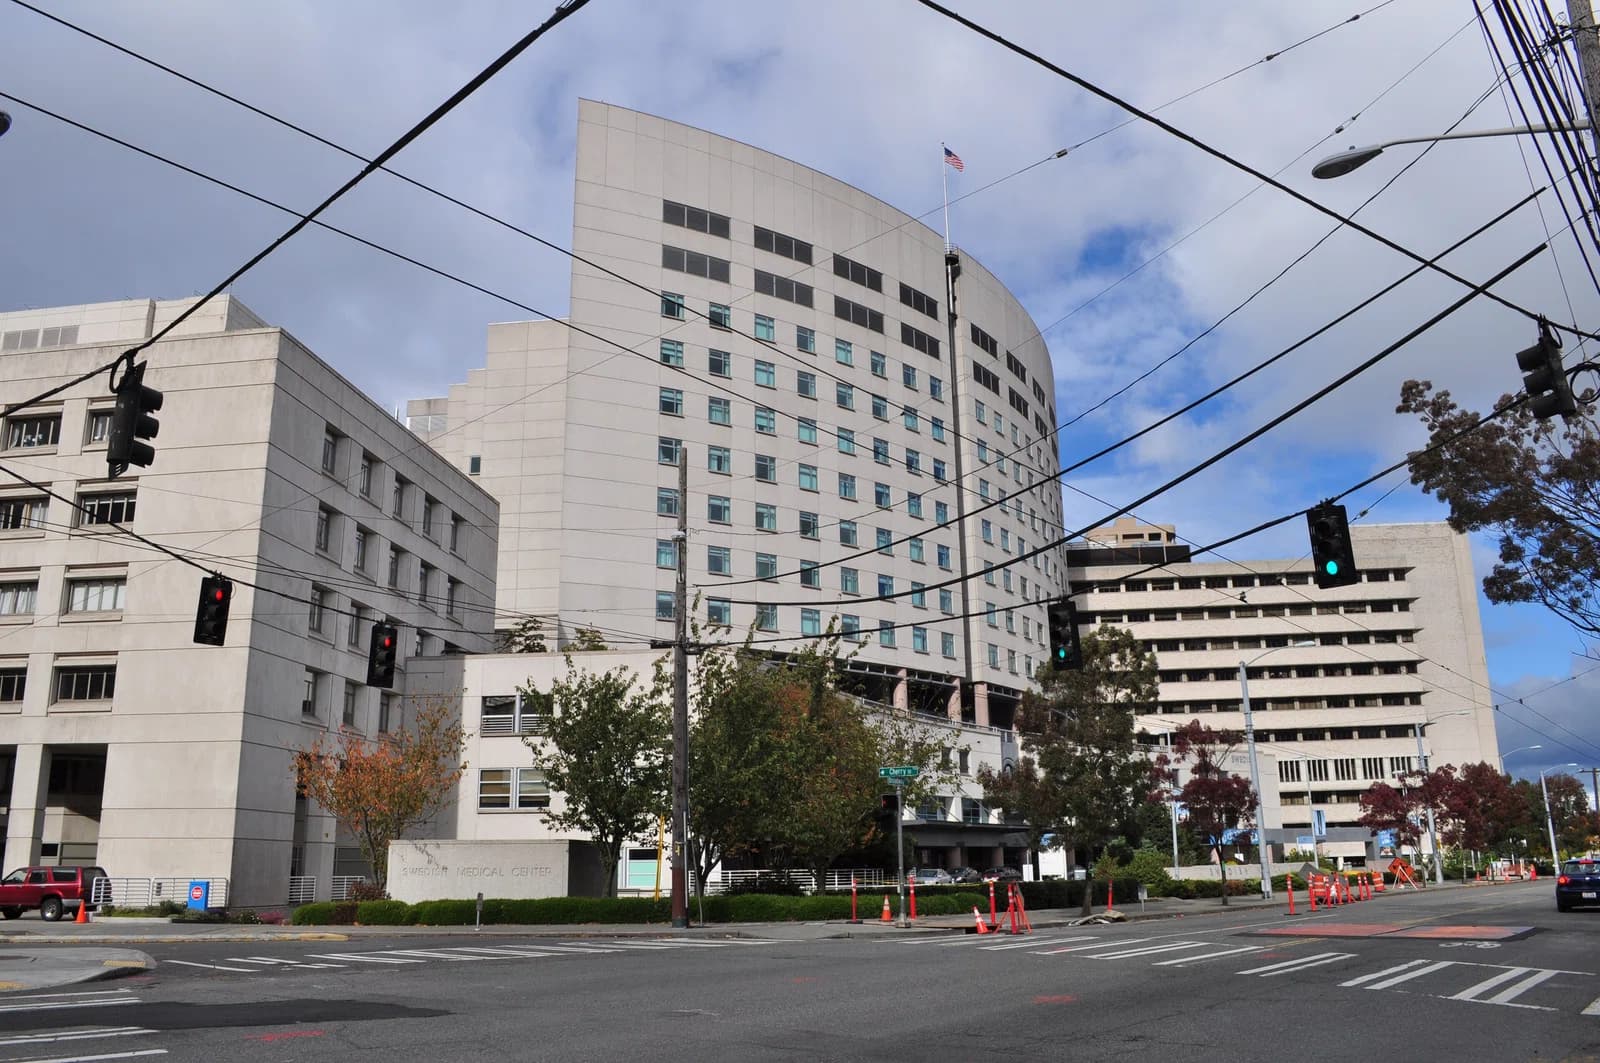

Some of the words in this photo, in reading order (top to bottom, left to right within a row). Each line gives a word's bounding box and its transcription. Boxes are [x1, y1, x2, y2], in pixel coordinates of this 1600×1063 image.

[889, 768, 906, 776] Cherry
[457, 867, 504, 877] MEDICAL
[512, 867, 552, 877] CENTER
